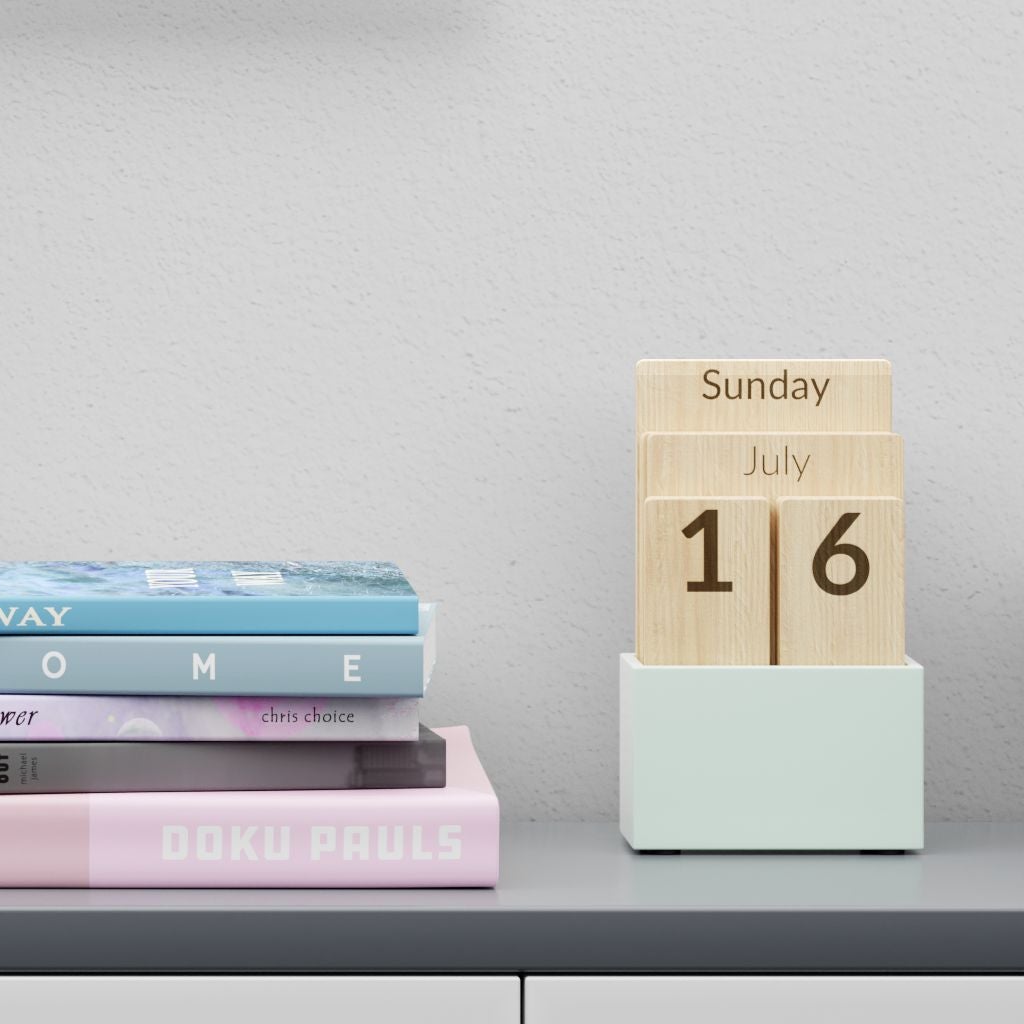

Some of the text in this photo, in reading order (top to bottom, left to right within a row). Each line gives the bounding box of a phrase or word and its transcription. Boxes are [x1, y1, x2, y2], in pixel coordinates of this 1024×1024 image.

[702, 369, 830, 407] Sunday
[743, 445, 811, 482] July
[261, 706, 355, 723] chris choice
[19, 752, 28, 785] michael
[161, 824, 463, 861] DOKU PAULS
